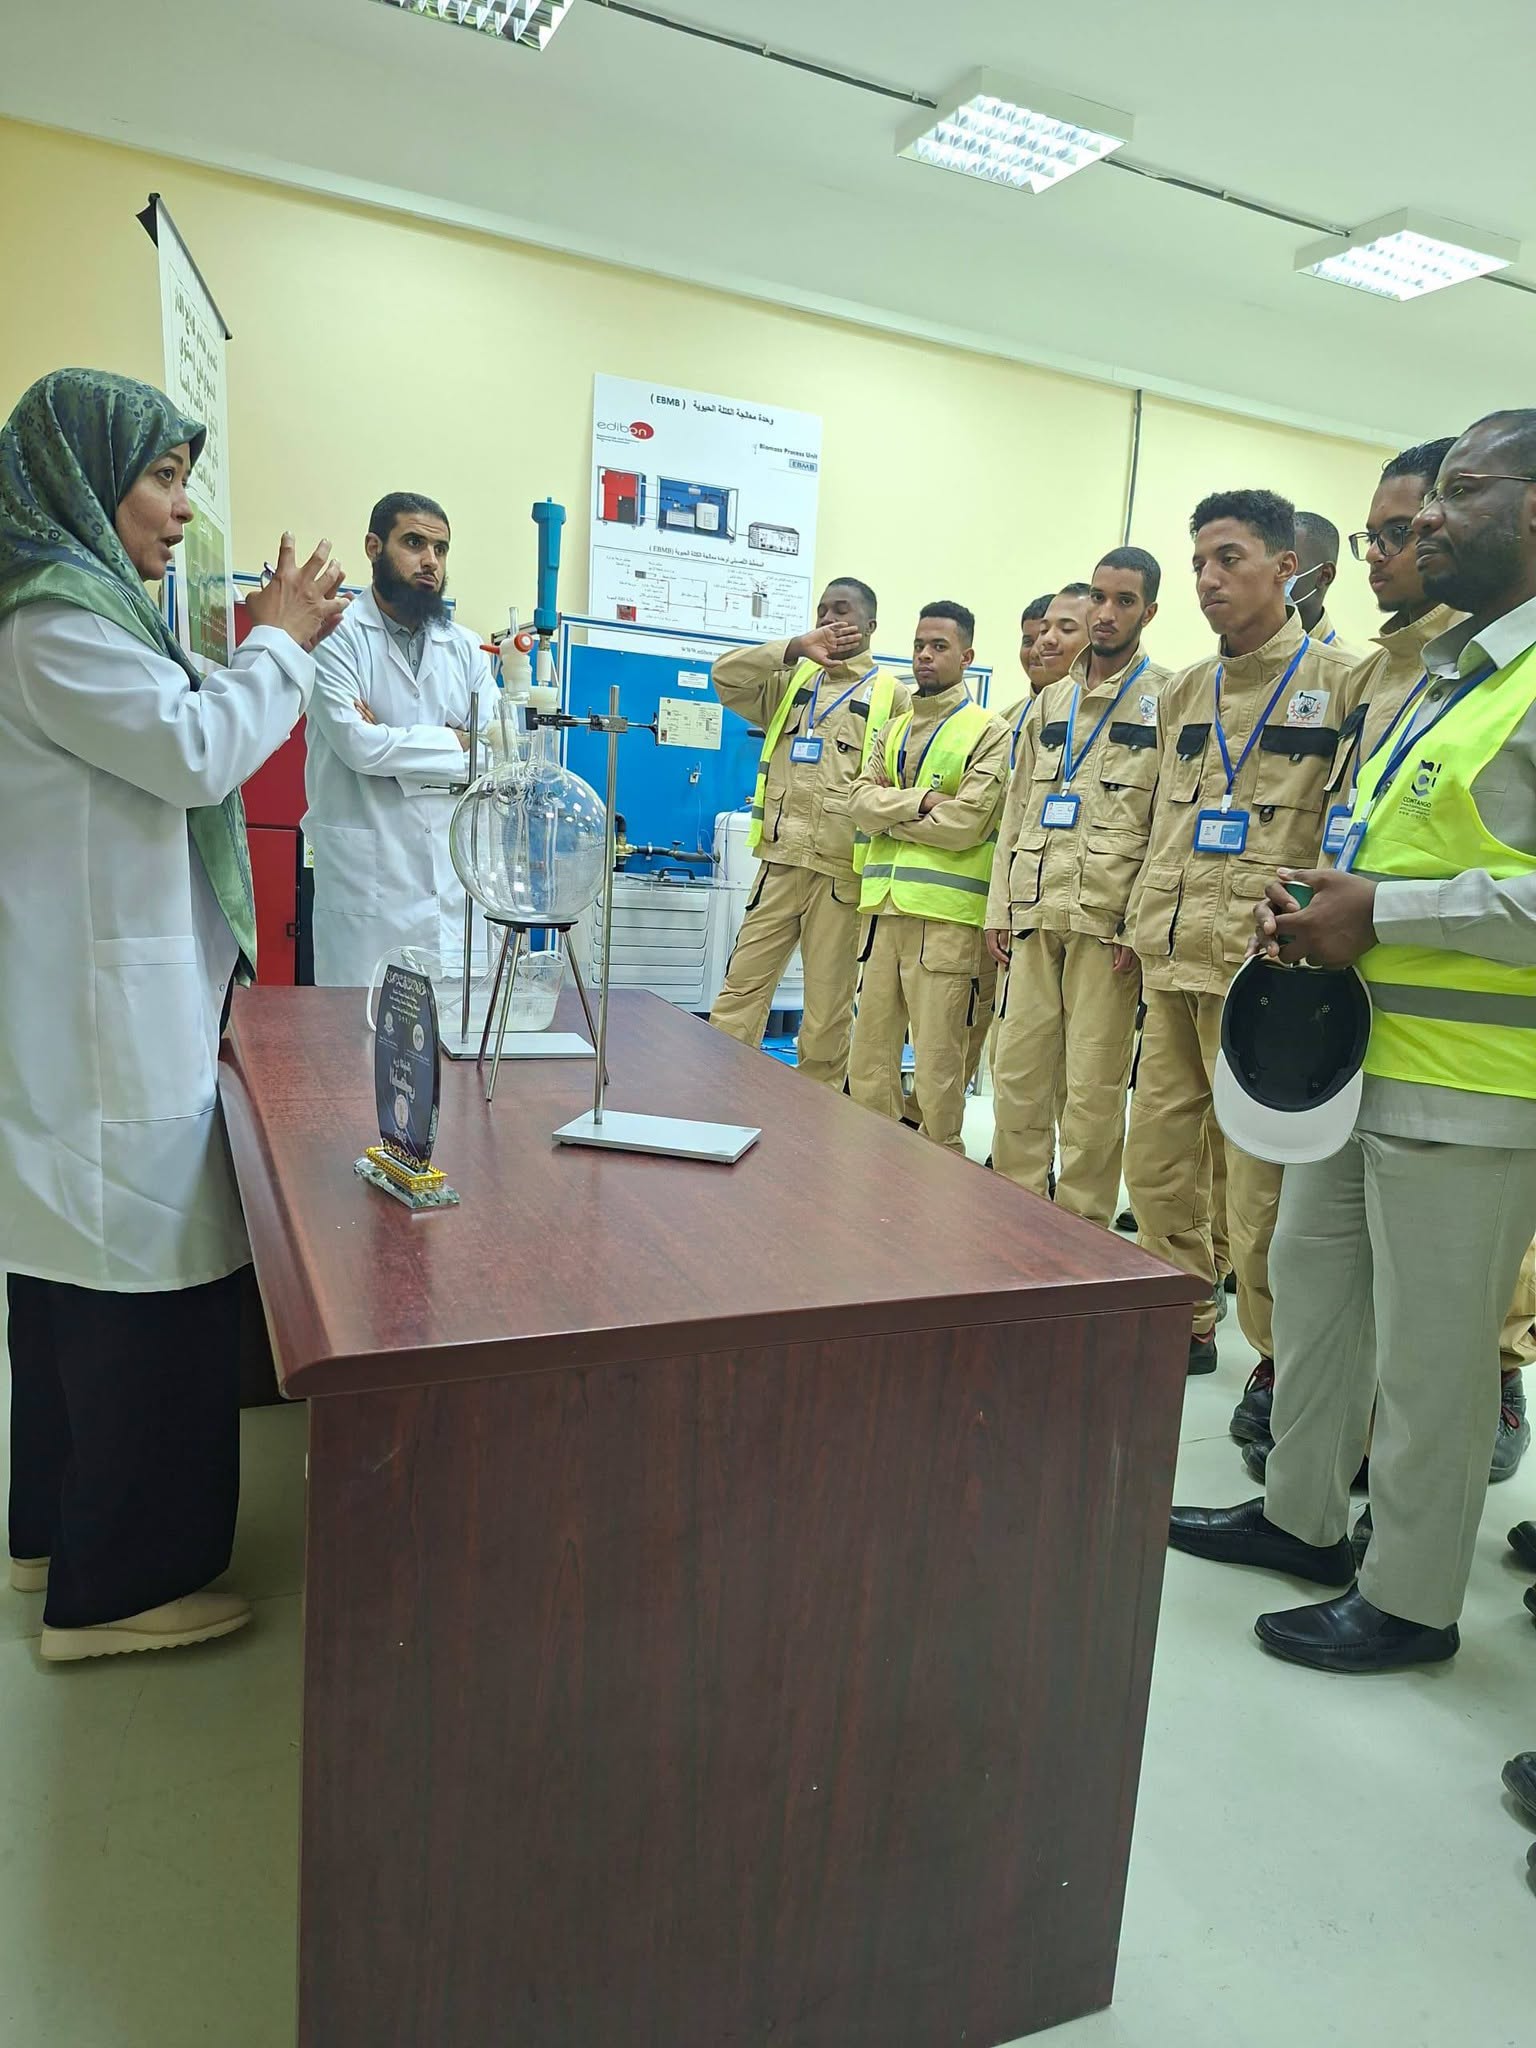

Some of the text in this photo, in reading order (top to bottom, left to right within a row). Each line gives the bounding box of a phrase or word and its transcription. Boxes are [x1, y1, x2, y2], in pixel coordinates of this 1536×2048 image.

[656, 395, 680, 407] EBMB
[596, 421, 647, 437] edibon
[805, 451, 818, 460] Unit
[1402, 796, 1432, 808] CONTANGO
